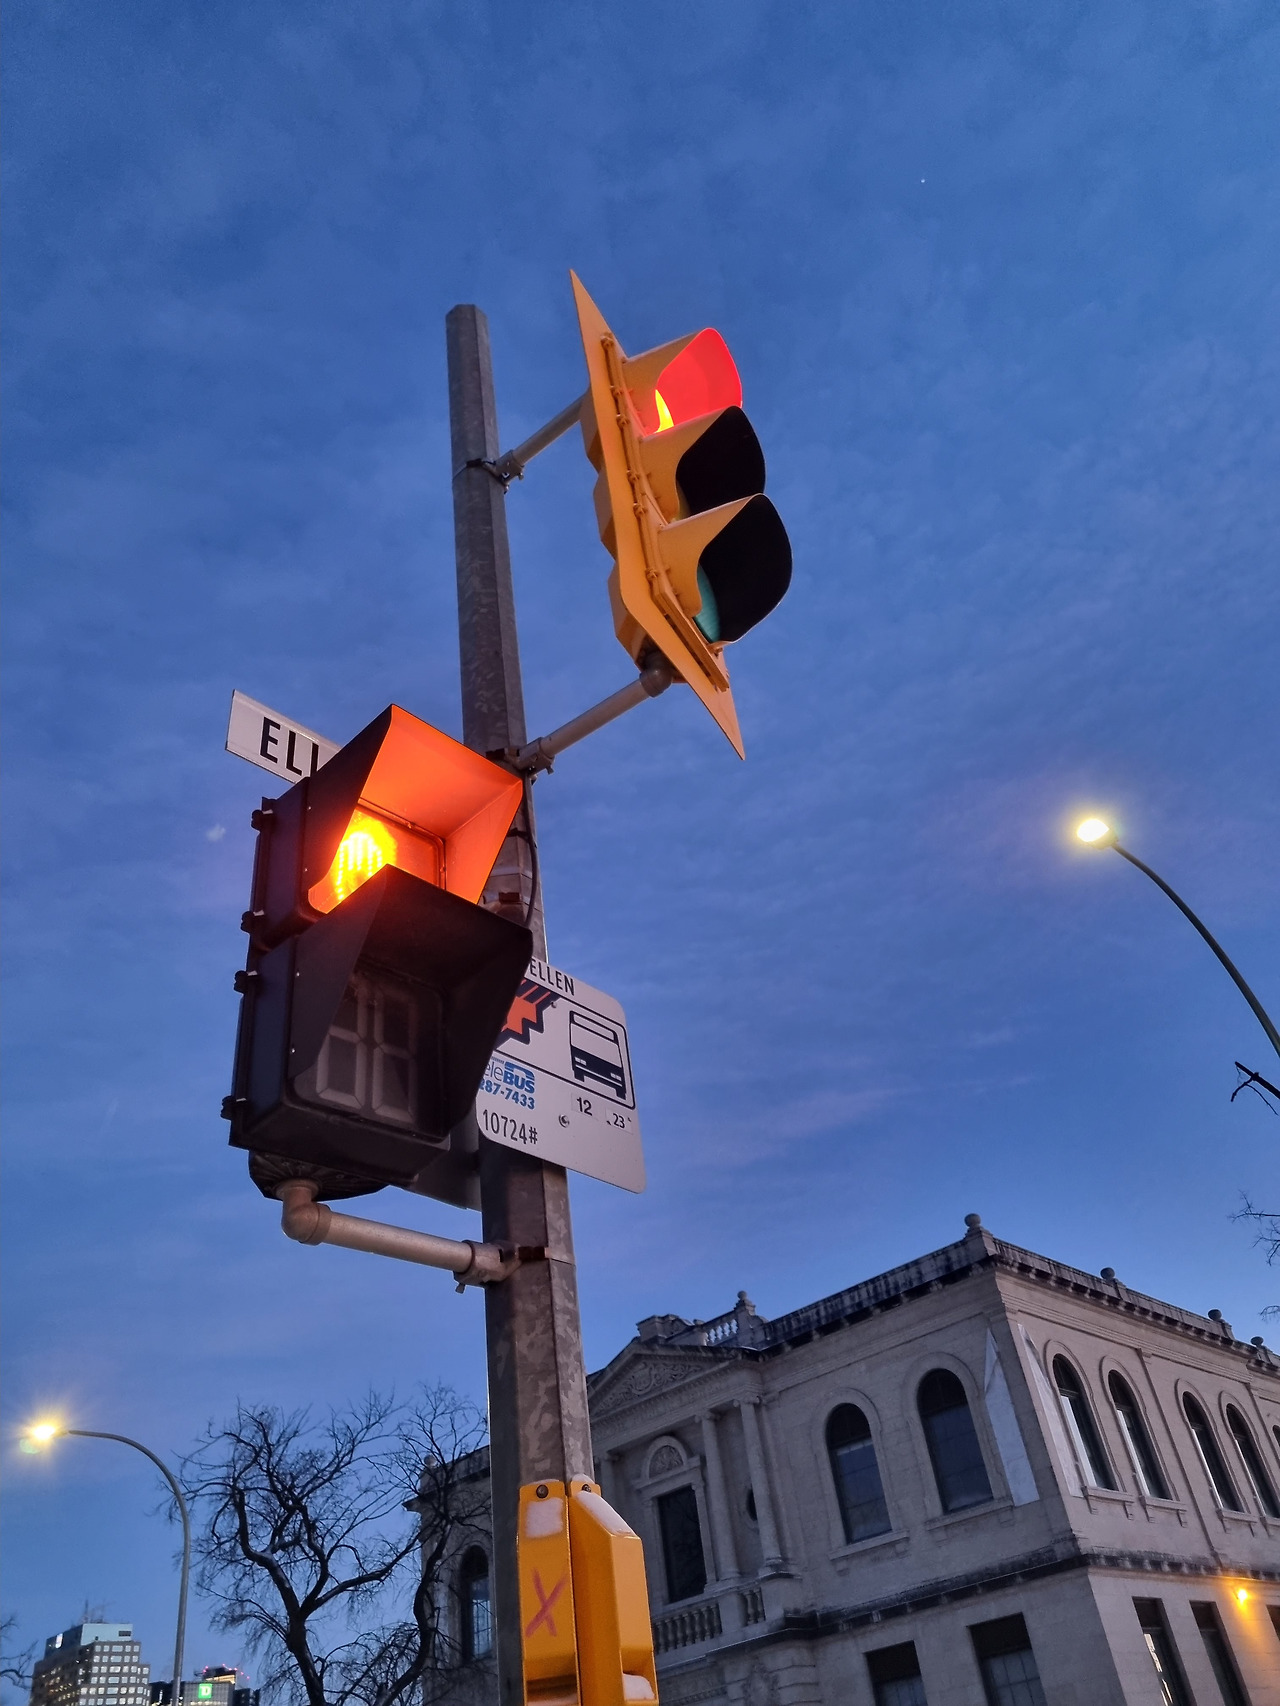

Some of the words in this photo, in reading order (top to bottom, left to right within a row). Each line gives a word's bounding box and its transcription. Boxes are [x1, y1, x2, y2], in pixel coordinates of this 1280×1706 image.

[529, 958, 575, 996] ELLEN
[576, 1096, 593, 1116] 12
[482, 1109, 538, 1145] 10724#
[612, 1112, 625, 1129] 23
[200, 1685, 212, 1697] TD
